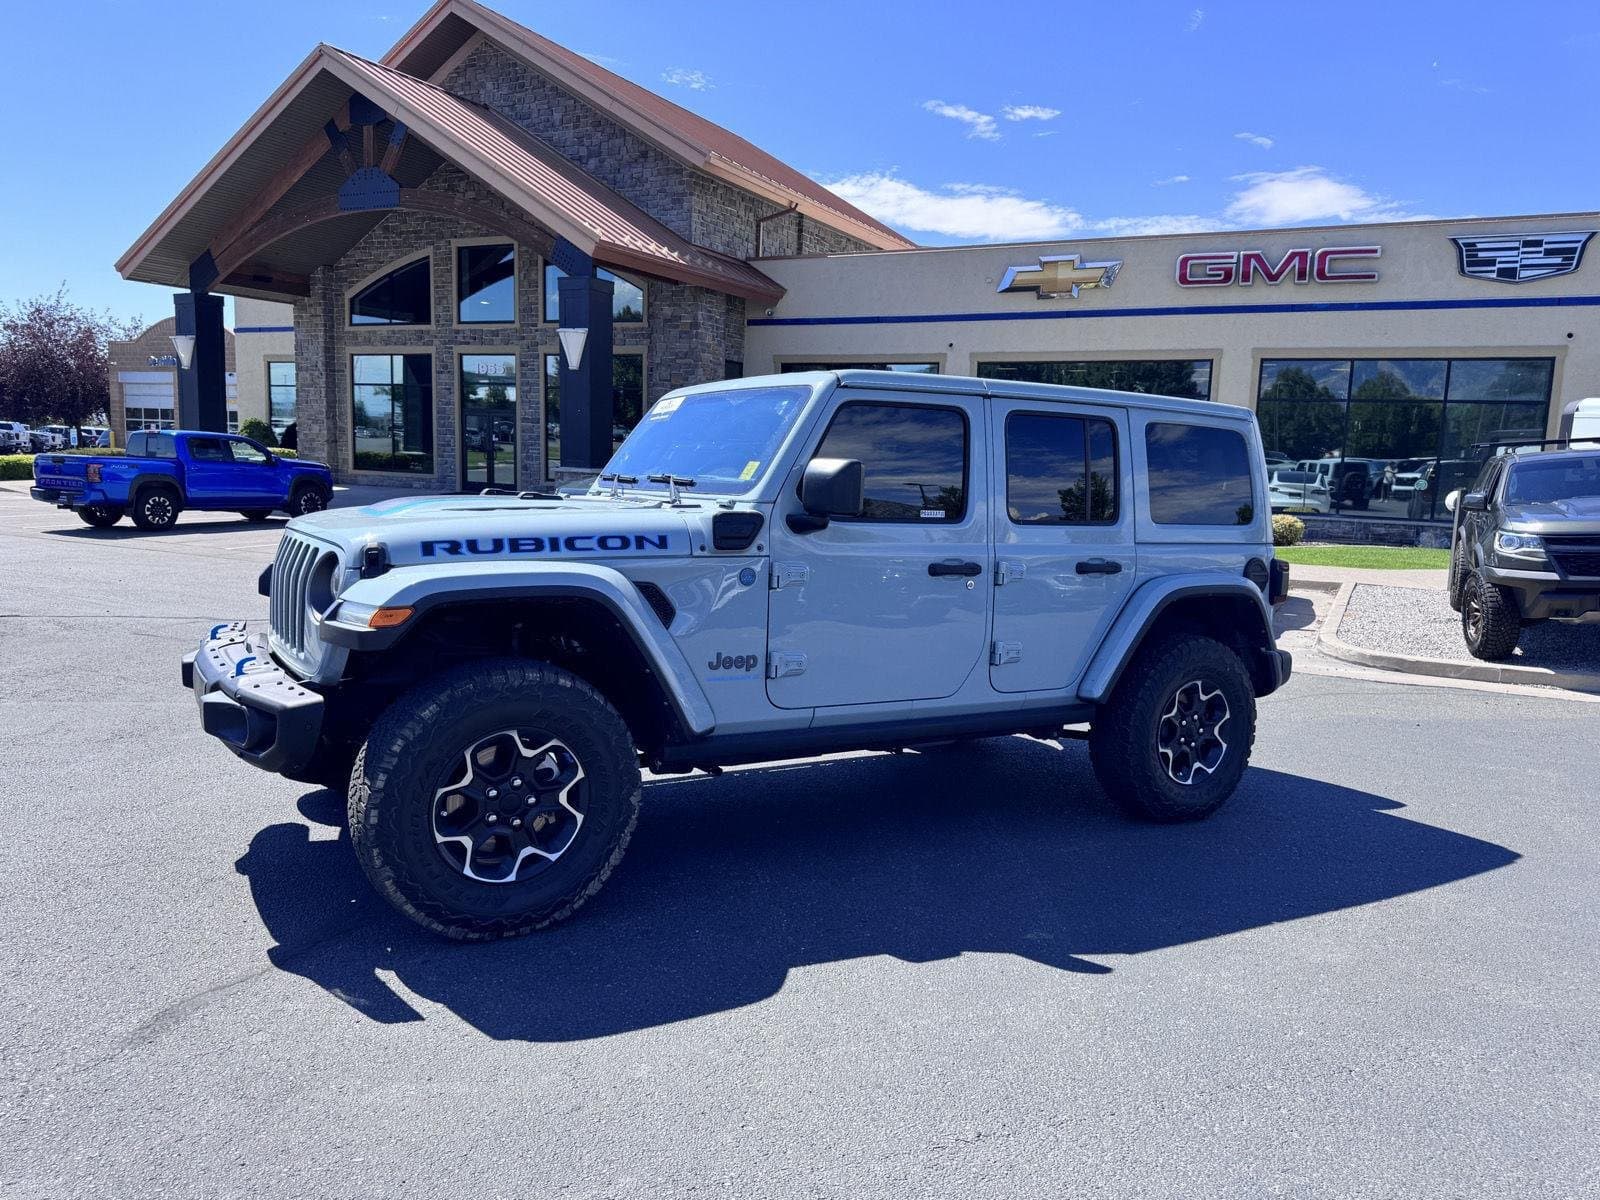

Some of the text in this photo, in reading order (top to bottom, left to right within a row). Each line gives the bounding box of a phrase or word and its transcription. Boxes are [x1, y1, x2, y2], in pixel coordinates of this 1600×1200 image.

[1176, 246, 1382, 288] GMC
[420, 535, 668, 557] RUBICON
[708, 652, 758, 671] Jeep
